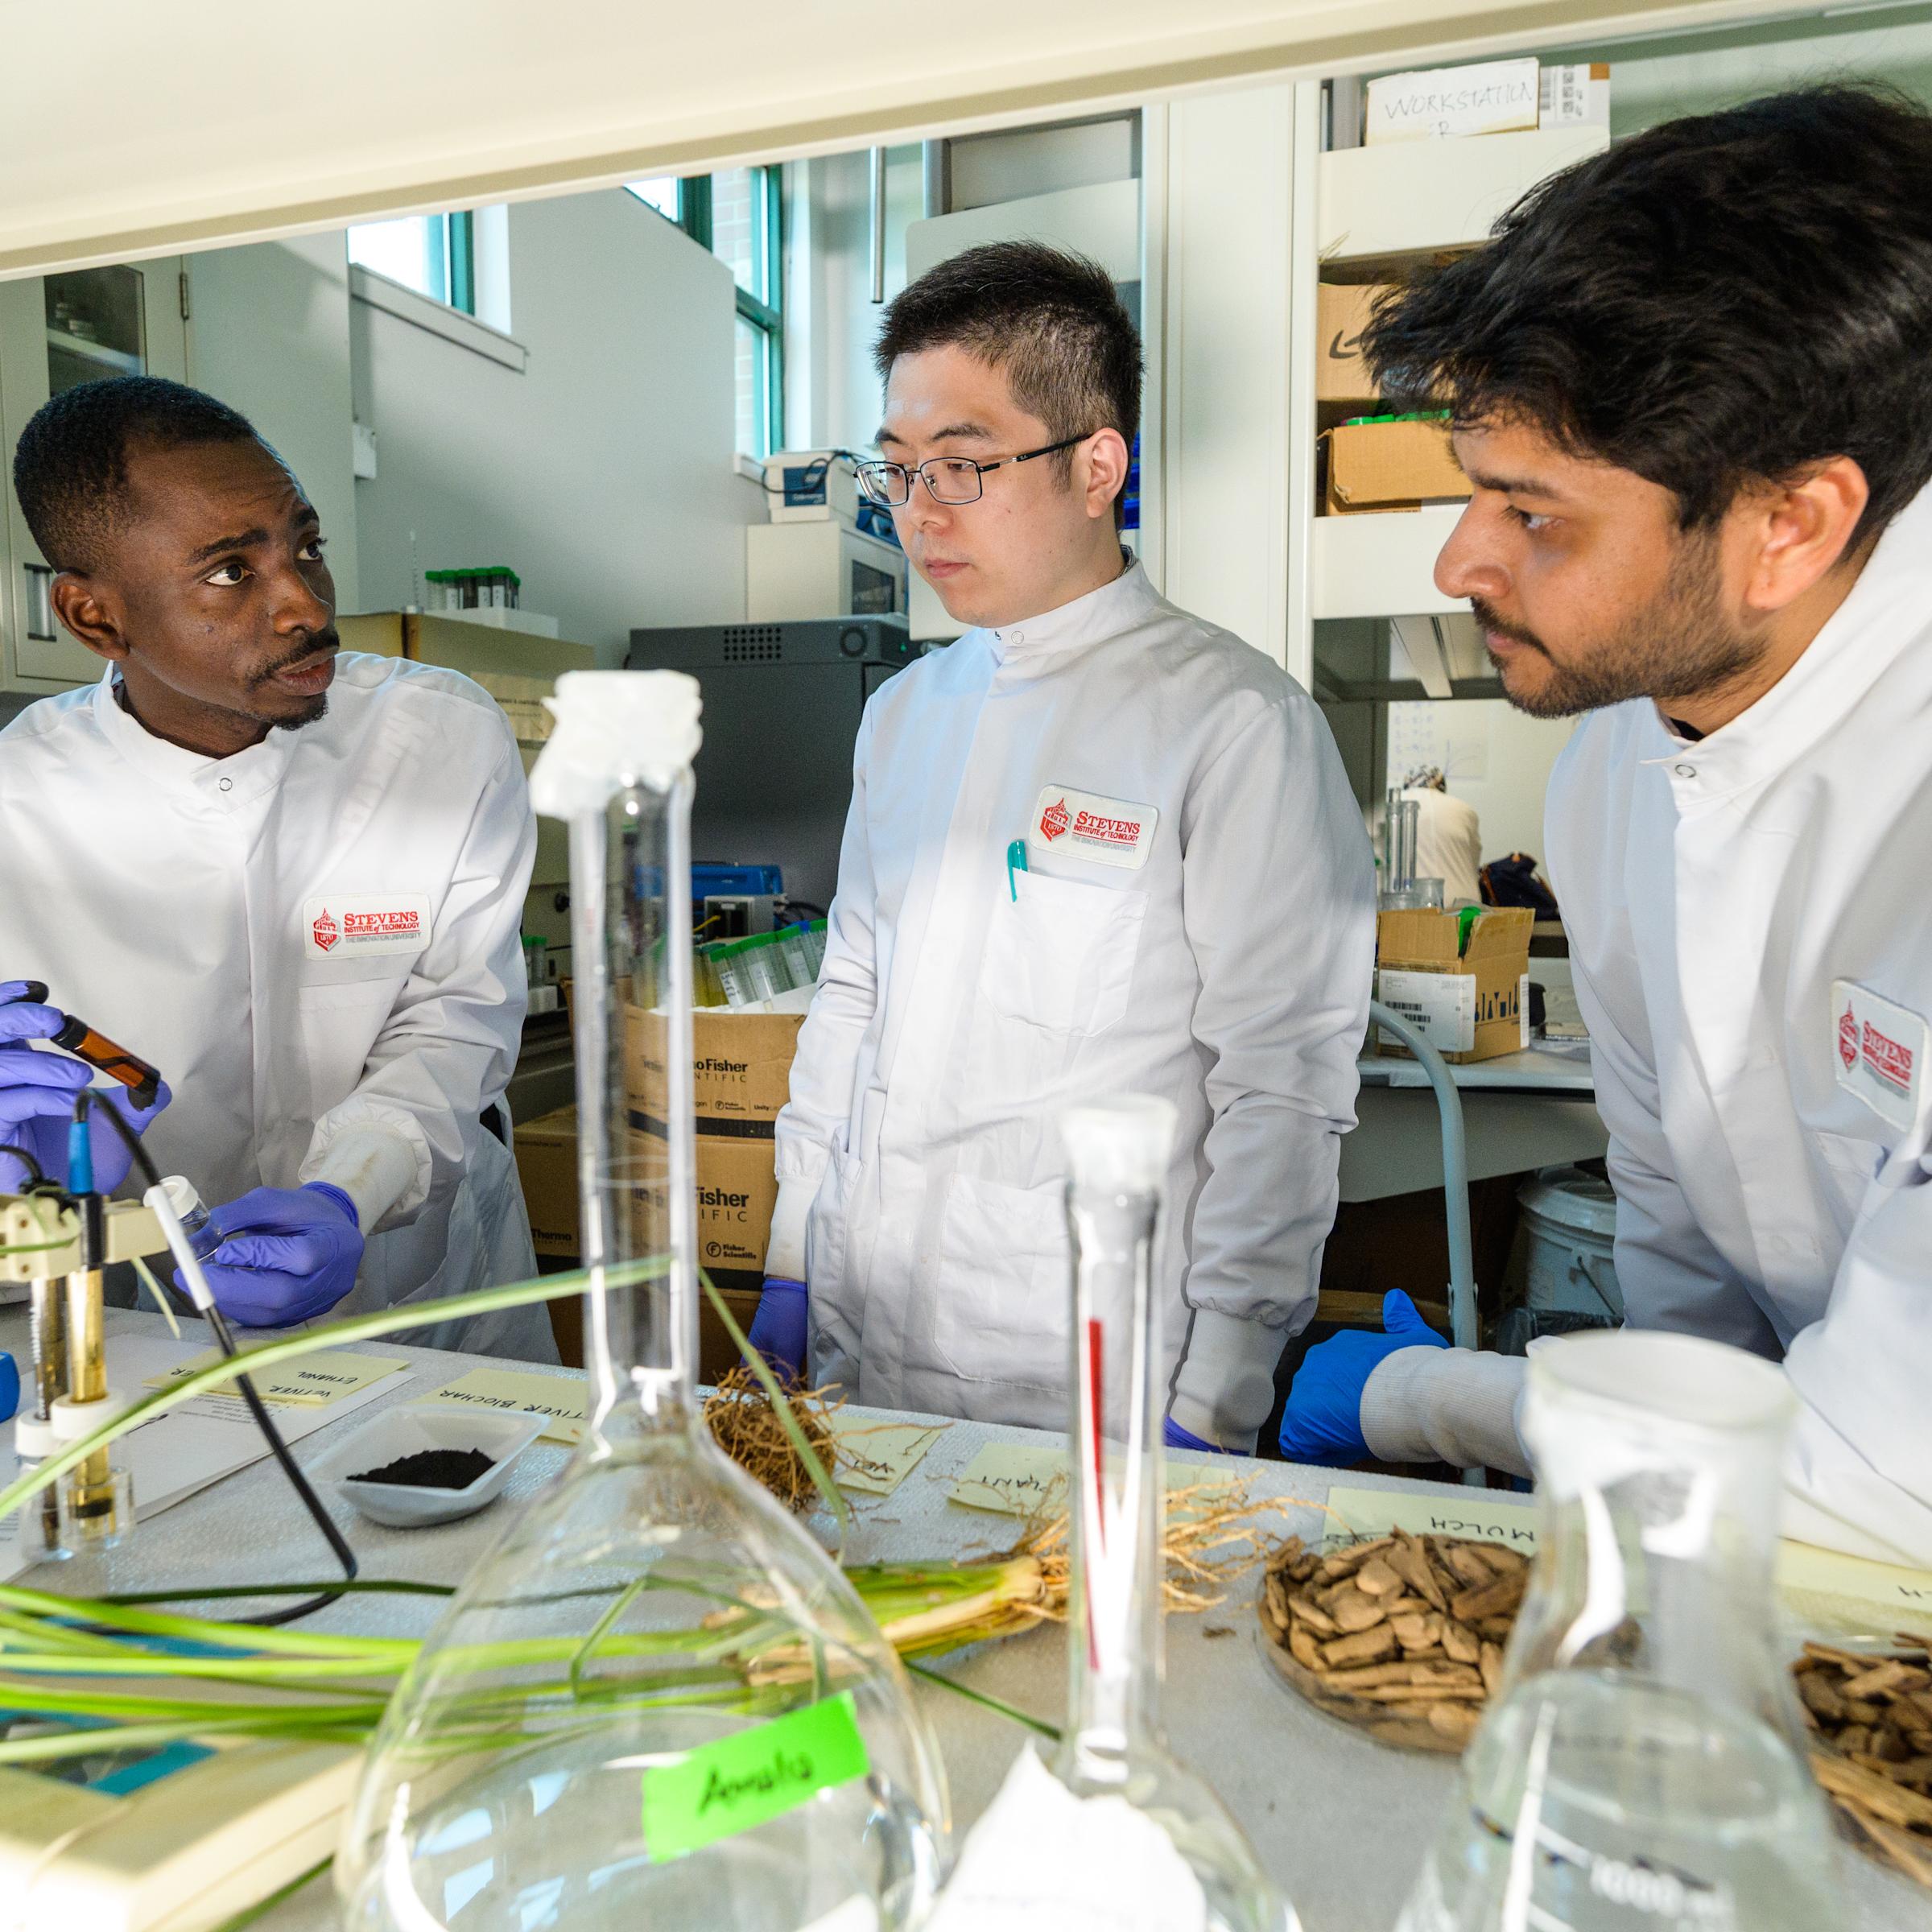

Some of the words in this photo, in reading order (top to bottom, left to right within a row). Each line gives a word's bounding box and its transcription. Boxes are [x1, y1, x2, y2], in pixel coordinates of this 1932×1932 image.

[1385, 81, 1532, 119] WORKSTATION
[1073, 824, 1100, 836] INSTITUTE
[1108, 831, 1139, 842] TECHNOLOGY
[345, 925, 374, 933] INSTITUTE
[382, 922, 419, 931] TECHNOLOGY
[298, 1370, 359, 1385] ETHANOL
[269, 1384, 331, 1398] VETIVER
[522, 1403, 588, 1419] TIVER
[1430, 1516, 1534, 1543] MULCH
